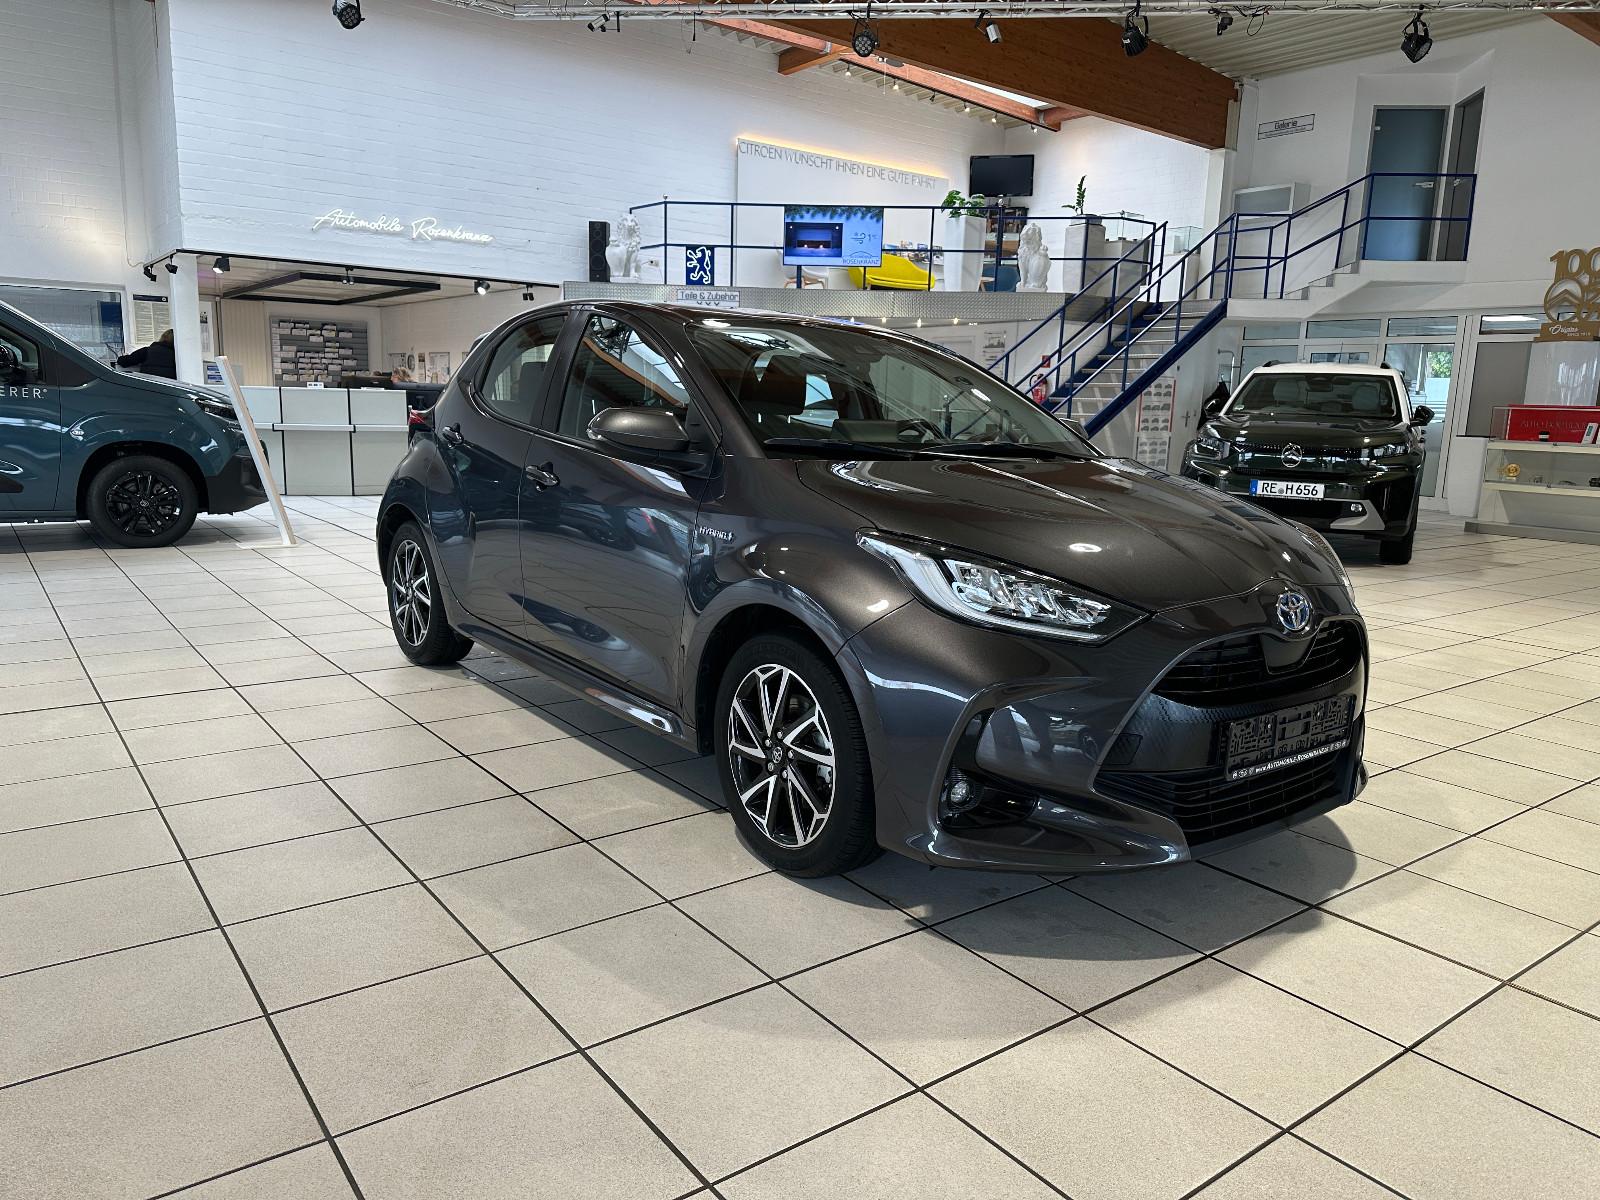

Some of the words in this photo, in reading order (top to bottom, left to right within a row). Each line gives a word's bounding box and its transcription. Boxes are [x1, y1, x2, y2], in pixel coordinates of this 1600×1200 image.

[835, 159, 865, 175] IHNEN
[866, 166, 886, 181] EINE
[887, 170, 910, 185] GUTE
[911, 174, 936, 190] FAHRT
[312, 208, 404, 232] Automobile
[411, 217, 493, 244] Rosenkranz
[680, 290, 698, 300] Teile
[699, 291, 706, 300] &
[1261, 482, 1278, 494] RE
[1285, 483, 1294, 495] H
[1295, 484, 1318, 496] 656
[699, 526, 728, 540] HYBRID
